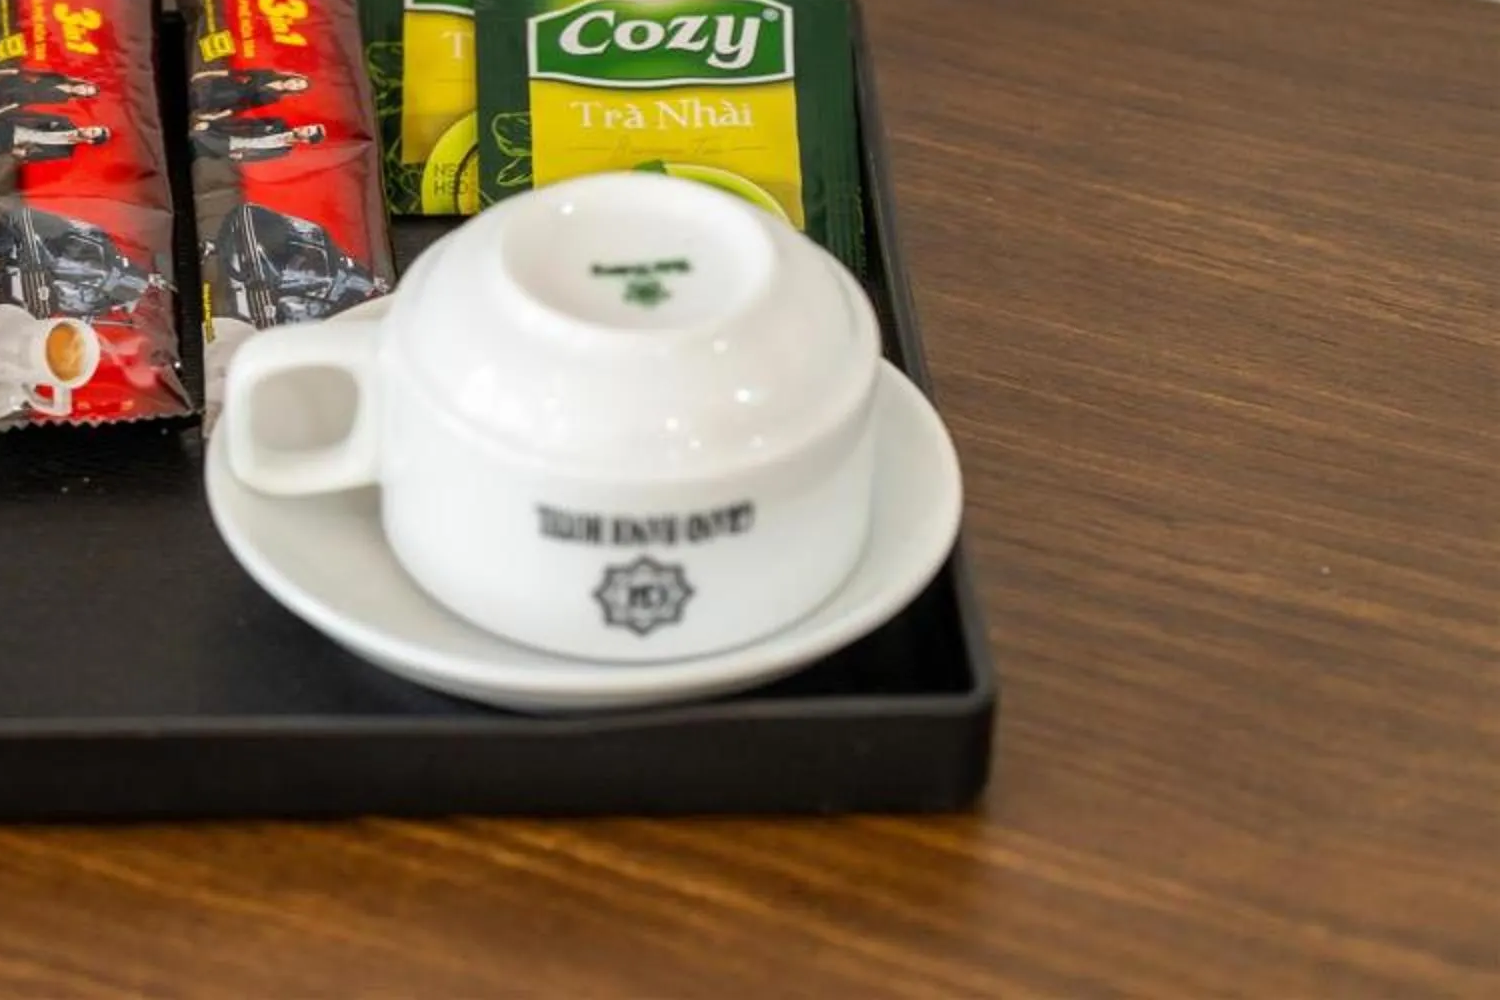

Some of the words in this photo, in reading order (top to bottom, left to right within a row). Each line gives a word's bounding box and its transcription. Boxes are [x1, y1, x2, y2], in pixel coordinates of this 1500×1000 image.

[559, 9, 762, 69] Cozy
[570, 100, 646, 130] Trà
[653, 96, 755, 130] Nhài
